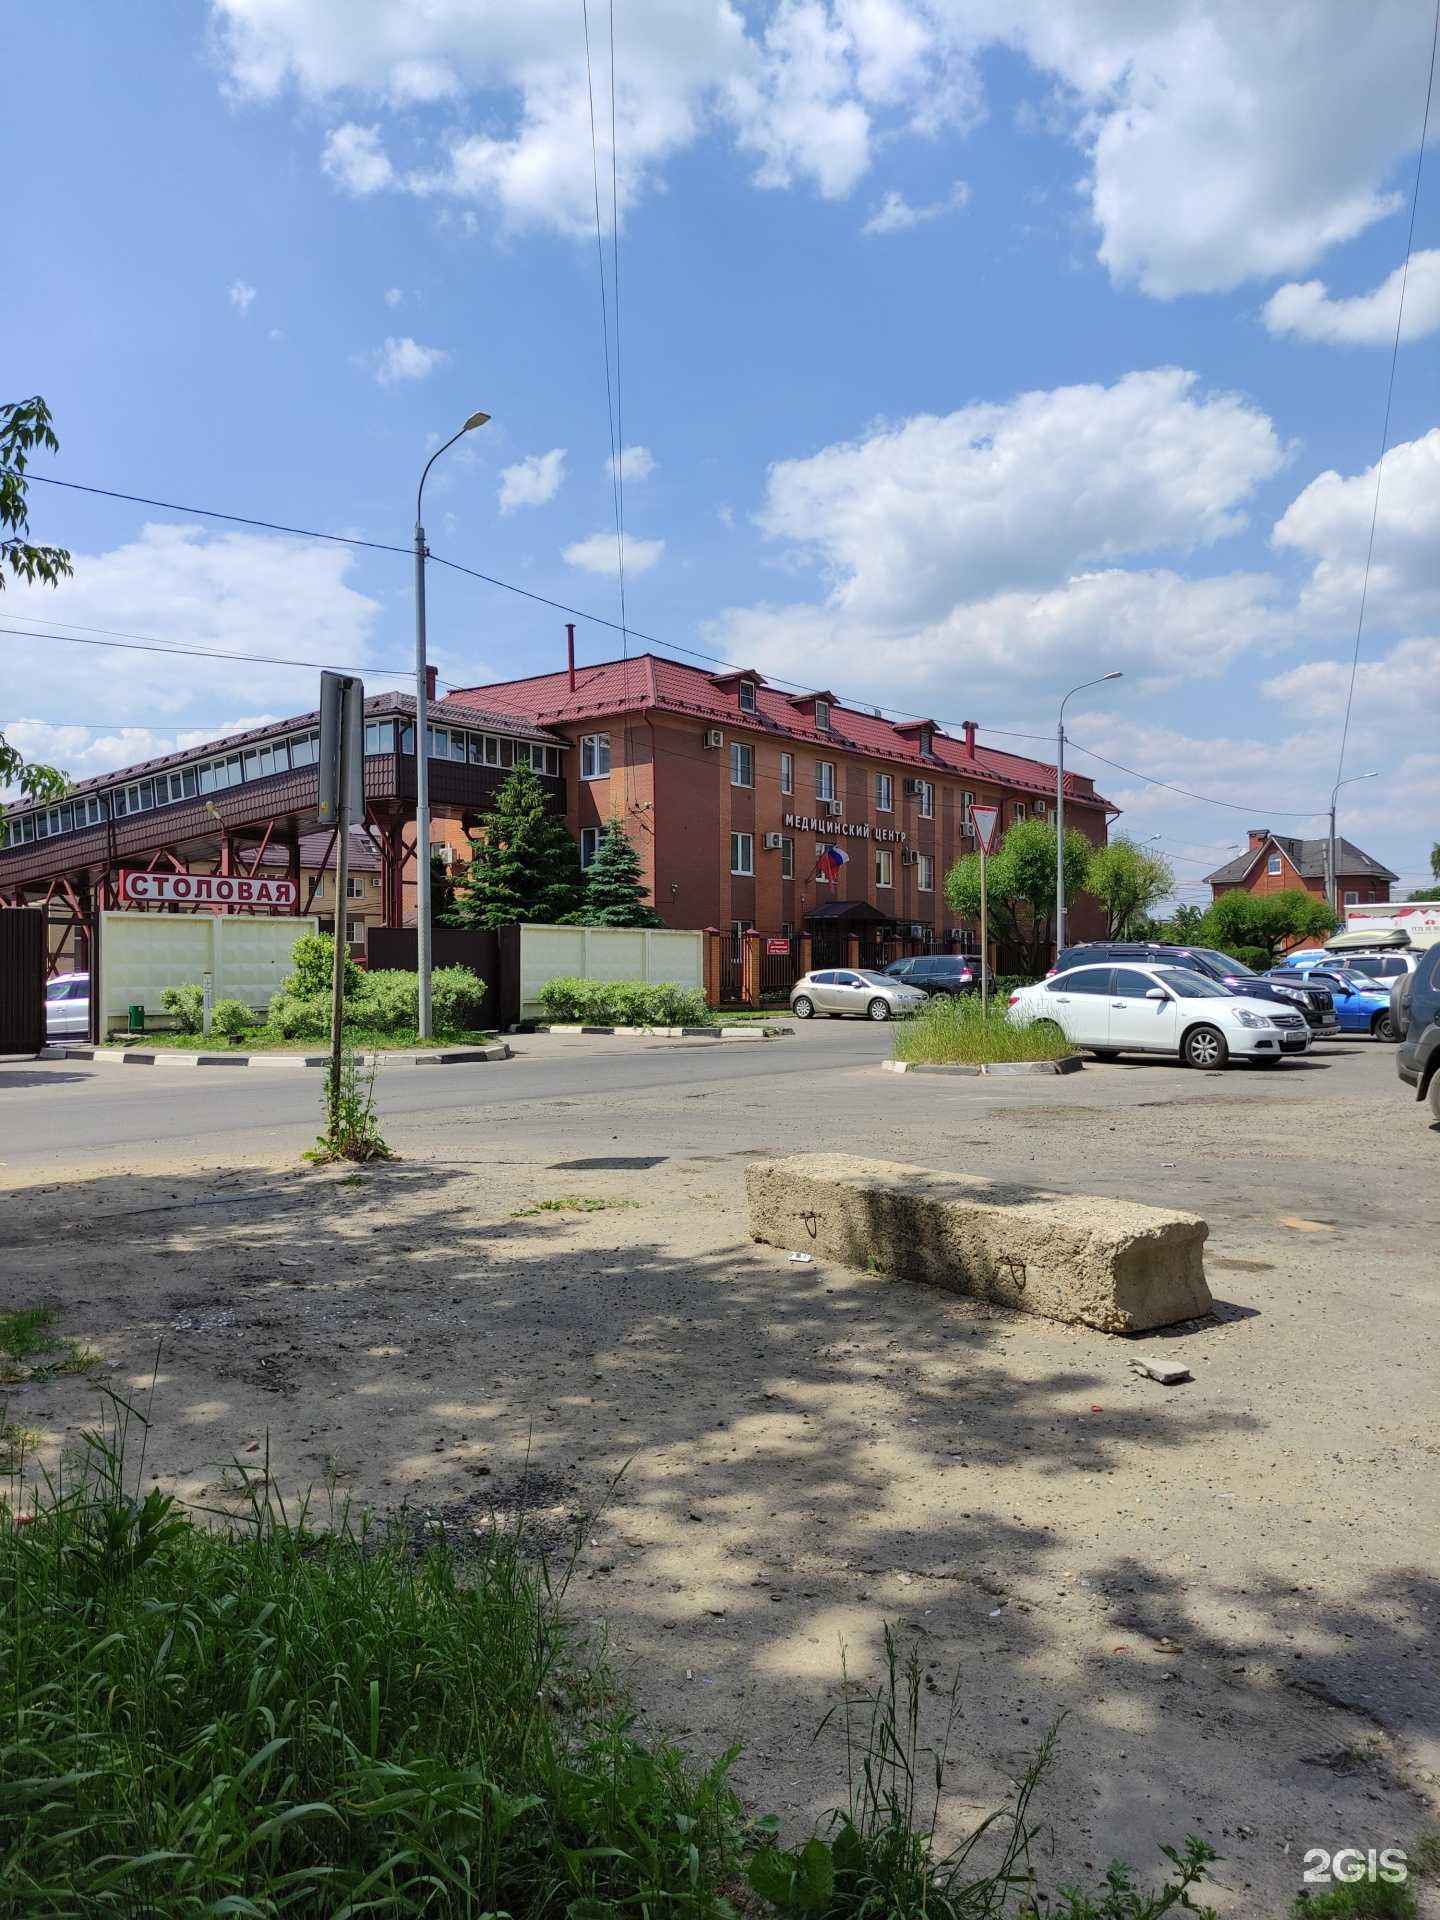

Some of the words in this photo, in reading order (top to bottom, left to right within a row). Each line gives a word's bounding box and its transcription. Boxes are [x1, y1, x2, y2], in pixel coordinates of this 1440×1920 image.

[785, 814, 869, 838] МЕДИЦИНСКИЙ
[875, 828, 906, 842] ЦЕНТР
[131, 875, 290, 902] СТОЛОВАЯ
